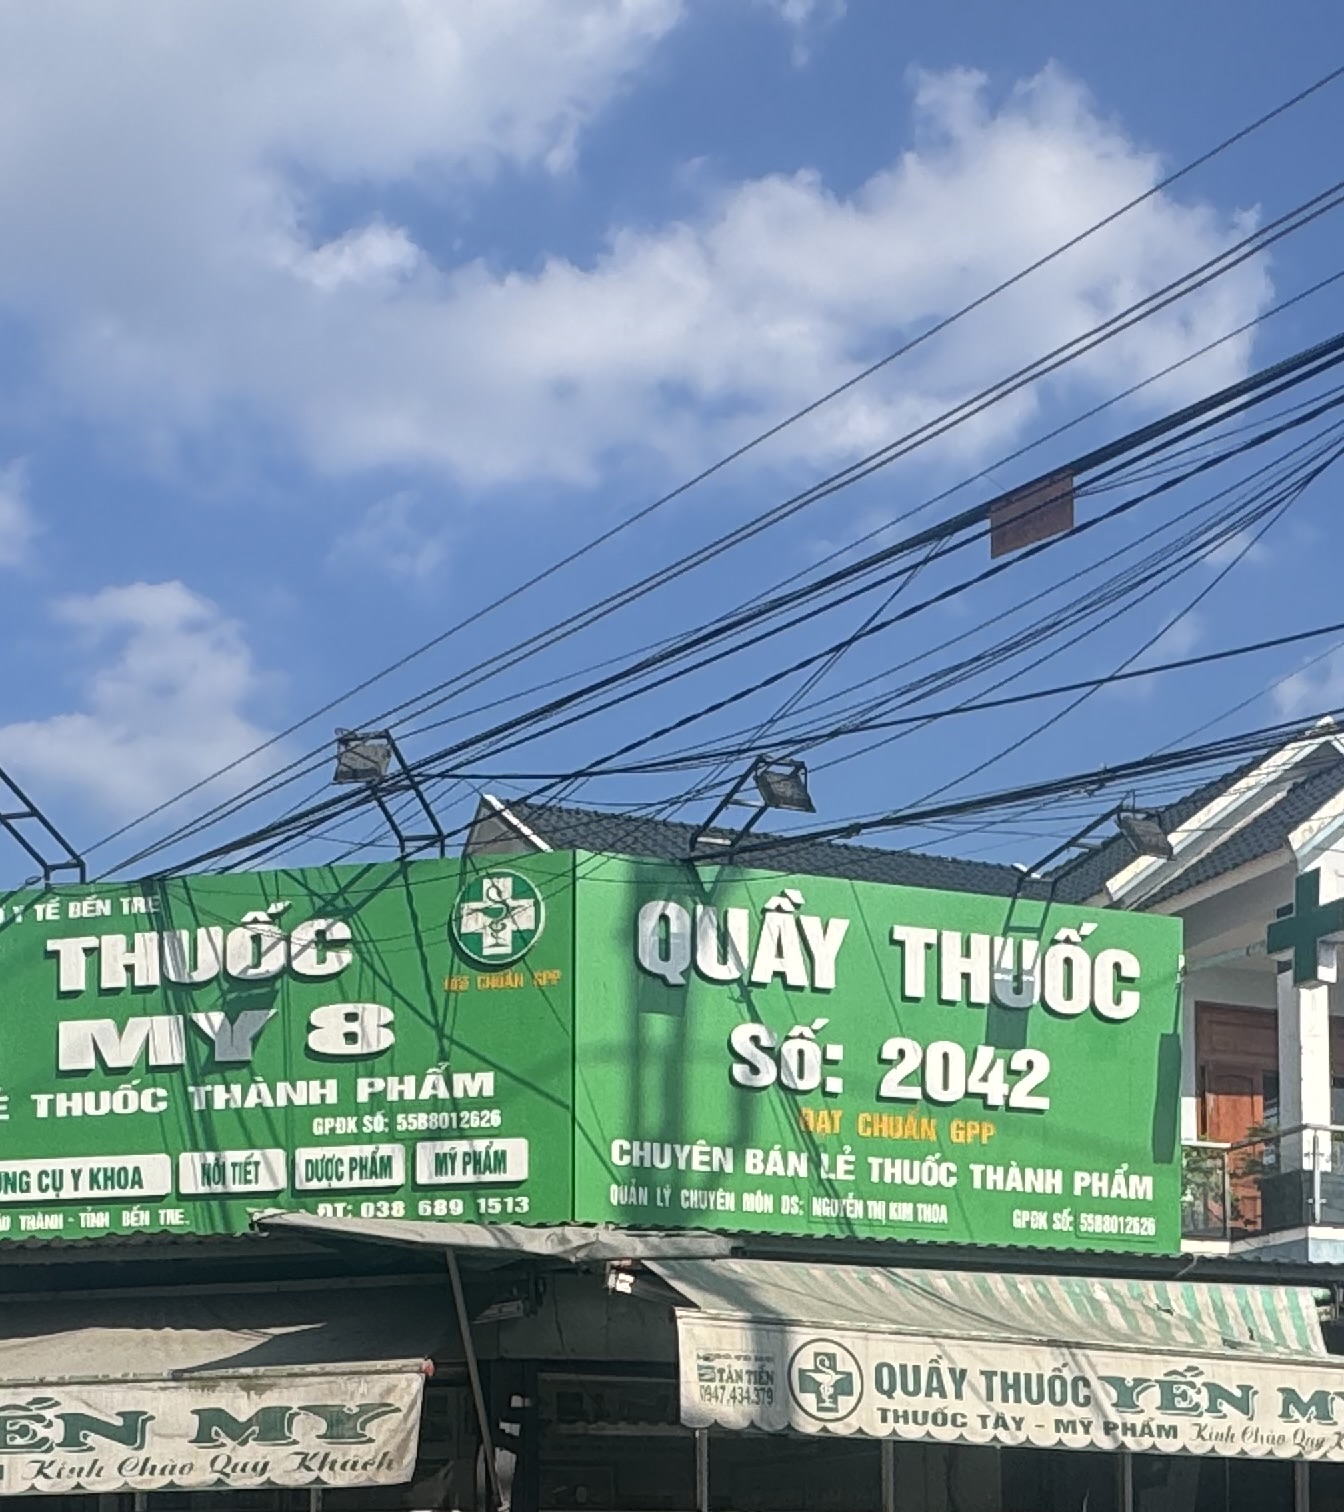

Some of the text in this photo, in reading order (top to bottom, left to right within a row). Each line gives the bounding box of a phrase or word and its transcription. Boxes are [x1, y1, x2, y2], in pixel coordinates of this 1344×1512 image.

[34, 897, 61, 922] TẾ
[68, 894, 112, 918] BẾN
[120, 896, 161, 916] TRE
[46, 900, 355, 993] THUỐC
[636, 889, 1141, 1021] QUẦY THUỐC
[58, 1007, 277, 1071] MY
[306, 1003, 395, 1055] 8
[729, 1018, 1051, 1110] SỐ: 2042
[31, 1077, 168, 1118] THUỐC
[188, 1077, 338, 1112] THÀNH
[356, 1063, 495, 1103] PHẨM
[313, 1116, 358, 1136] GPĐK
[949, 1118, 997, 1145] GPP
[230, 1151, 261, 1187] TIẾT
[304, 1145, 394, 1188] DƯỢC PHẨM
[434, 1141, 508, 1178] MỸ PHẨM
[610, 1139, 1154, 1201] CHUYÊN BÁN LẺ THUỐC THÀNH PHẨM
[37, 1169, 64, 1198] CỤ
[70, 1168, 83, 1193] Y
[88, 1165, 144, 1191] KHOA
[121, 1207, 150, 1228] BẾN
[360, 1200, 406, 1218] 038
[417, 1199, 464, 1217] 689
[476, 1196, 530, 1214] 1513
[680, 1187, 736, 1211] CHUYÊN
[888, 1202, 915, 1223] KIM
[916, 1203, 948, 1224] THOA
[875, 1354, 968, 1403] QUẦY
[979, 1361, 1091, 1408] THUỐC
[1097, 1366, 1259, 1421] YẾN
[190, 1402, 403, 1449] MY
[876, 1406, 1178, 1440] THUỐC TÂY MỸ PHẨM
